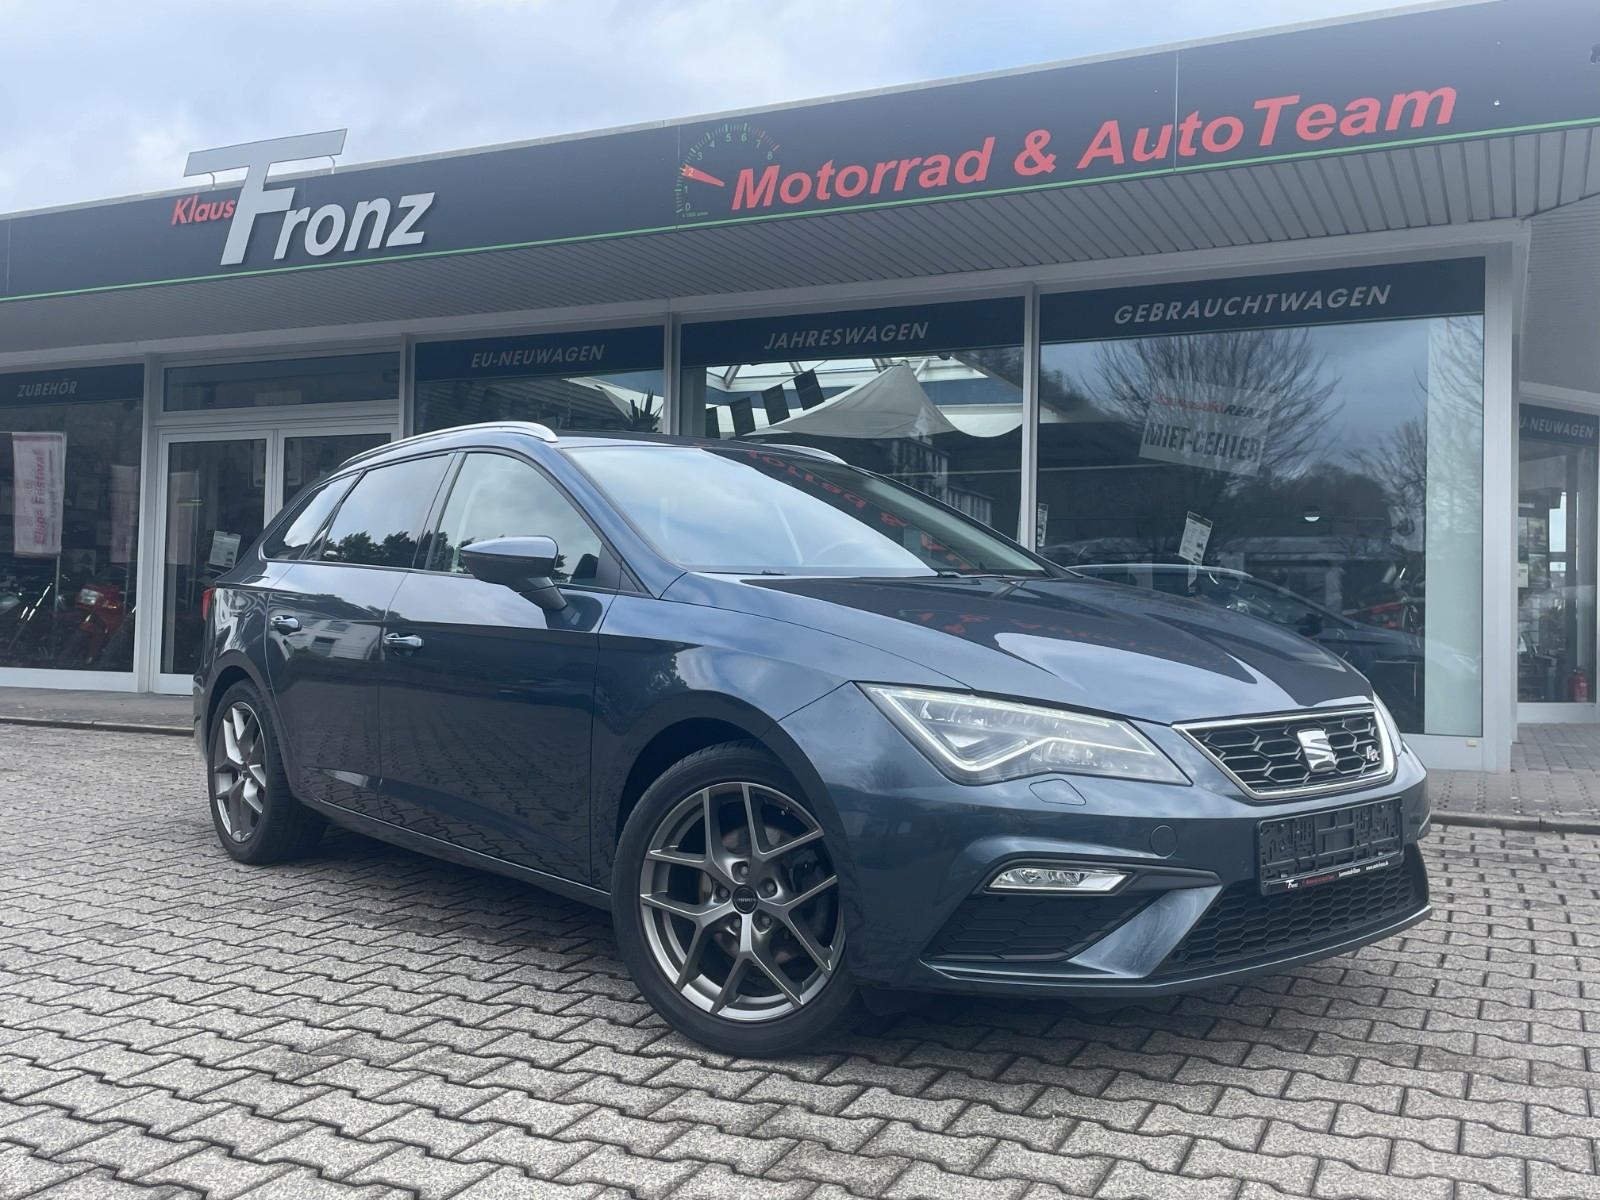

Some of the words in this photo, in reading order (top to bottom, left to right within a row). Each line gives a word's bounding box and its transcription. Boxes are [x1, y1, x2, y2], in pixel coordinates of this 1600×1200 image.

[731, 136, 996, 210] Motorrad
[1013, 129, 1056, 176] &
[1076, 86, 1457, 169] AutoTeam
[171, 195, 236, 226] Klaus
[183, 127, 436, 266] Fronz
[1114, 284, 1392, 325] GEBRAUCHTWAGEN
[763, 321, 929, 351] JAHRESWAGEN
[470, 344, 605, 369] EU-NEUWAGEN
[16, 378, 78, 398] ZUBEHÖR
